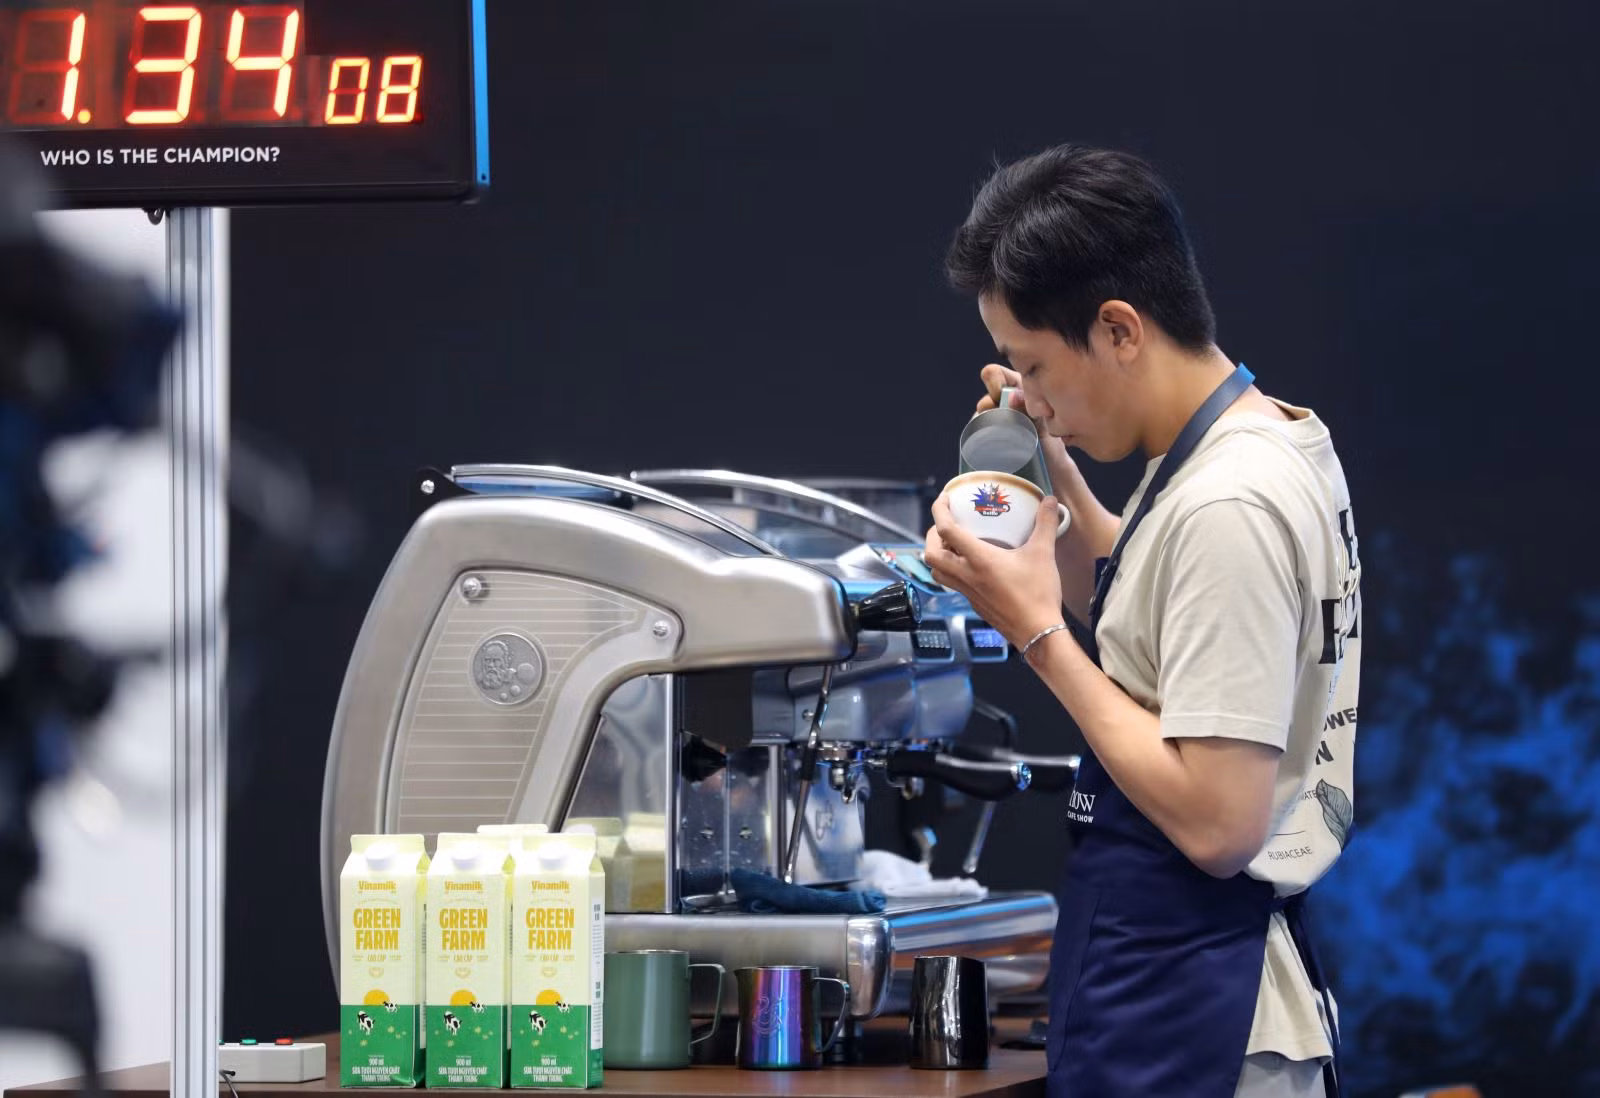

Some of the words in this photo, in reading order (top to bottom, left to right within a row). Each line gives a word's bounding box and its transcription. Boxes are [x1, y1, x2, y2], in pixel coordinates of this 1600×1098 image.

[325, 56, 423, 124] 08
[41, 150, 90, 166] WHO
[97, 150, 114, 164] IS
[120, 149, 158, 164] THE
[164, 147, 280, 164] CHAMPION?
[1077, 814, 1094, 823] SHOW
[1268, 846, 1312, 861] RUBIACEAE
[359, 880, 396, 891] Vinamilk
[445, 880, 482, 891] Vinamilk
[532, 880, 569, 891] Vinamilk
[353, 908, 401, 928] GREEN
[440, 908, 488, 928] GREEN
[526, 908, 574, 928] GREEN
[356, 930, 398, 950] FARM
[442, 930, 485, 950] FARM
[528, 930, 571, 950] FARM
